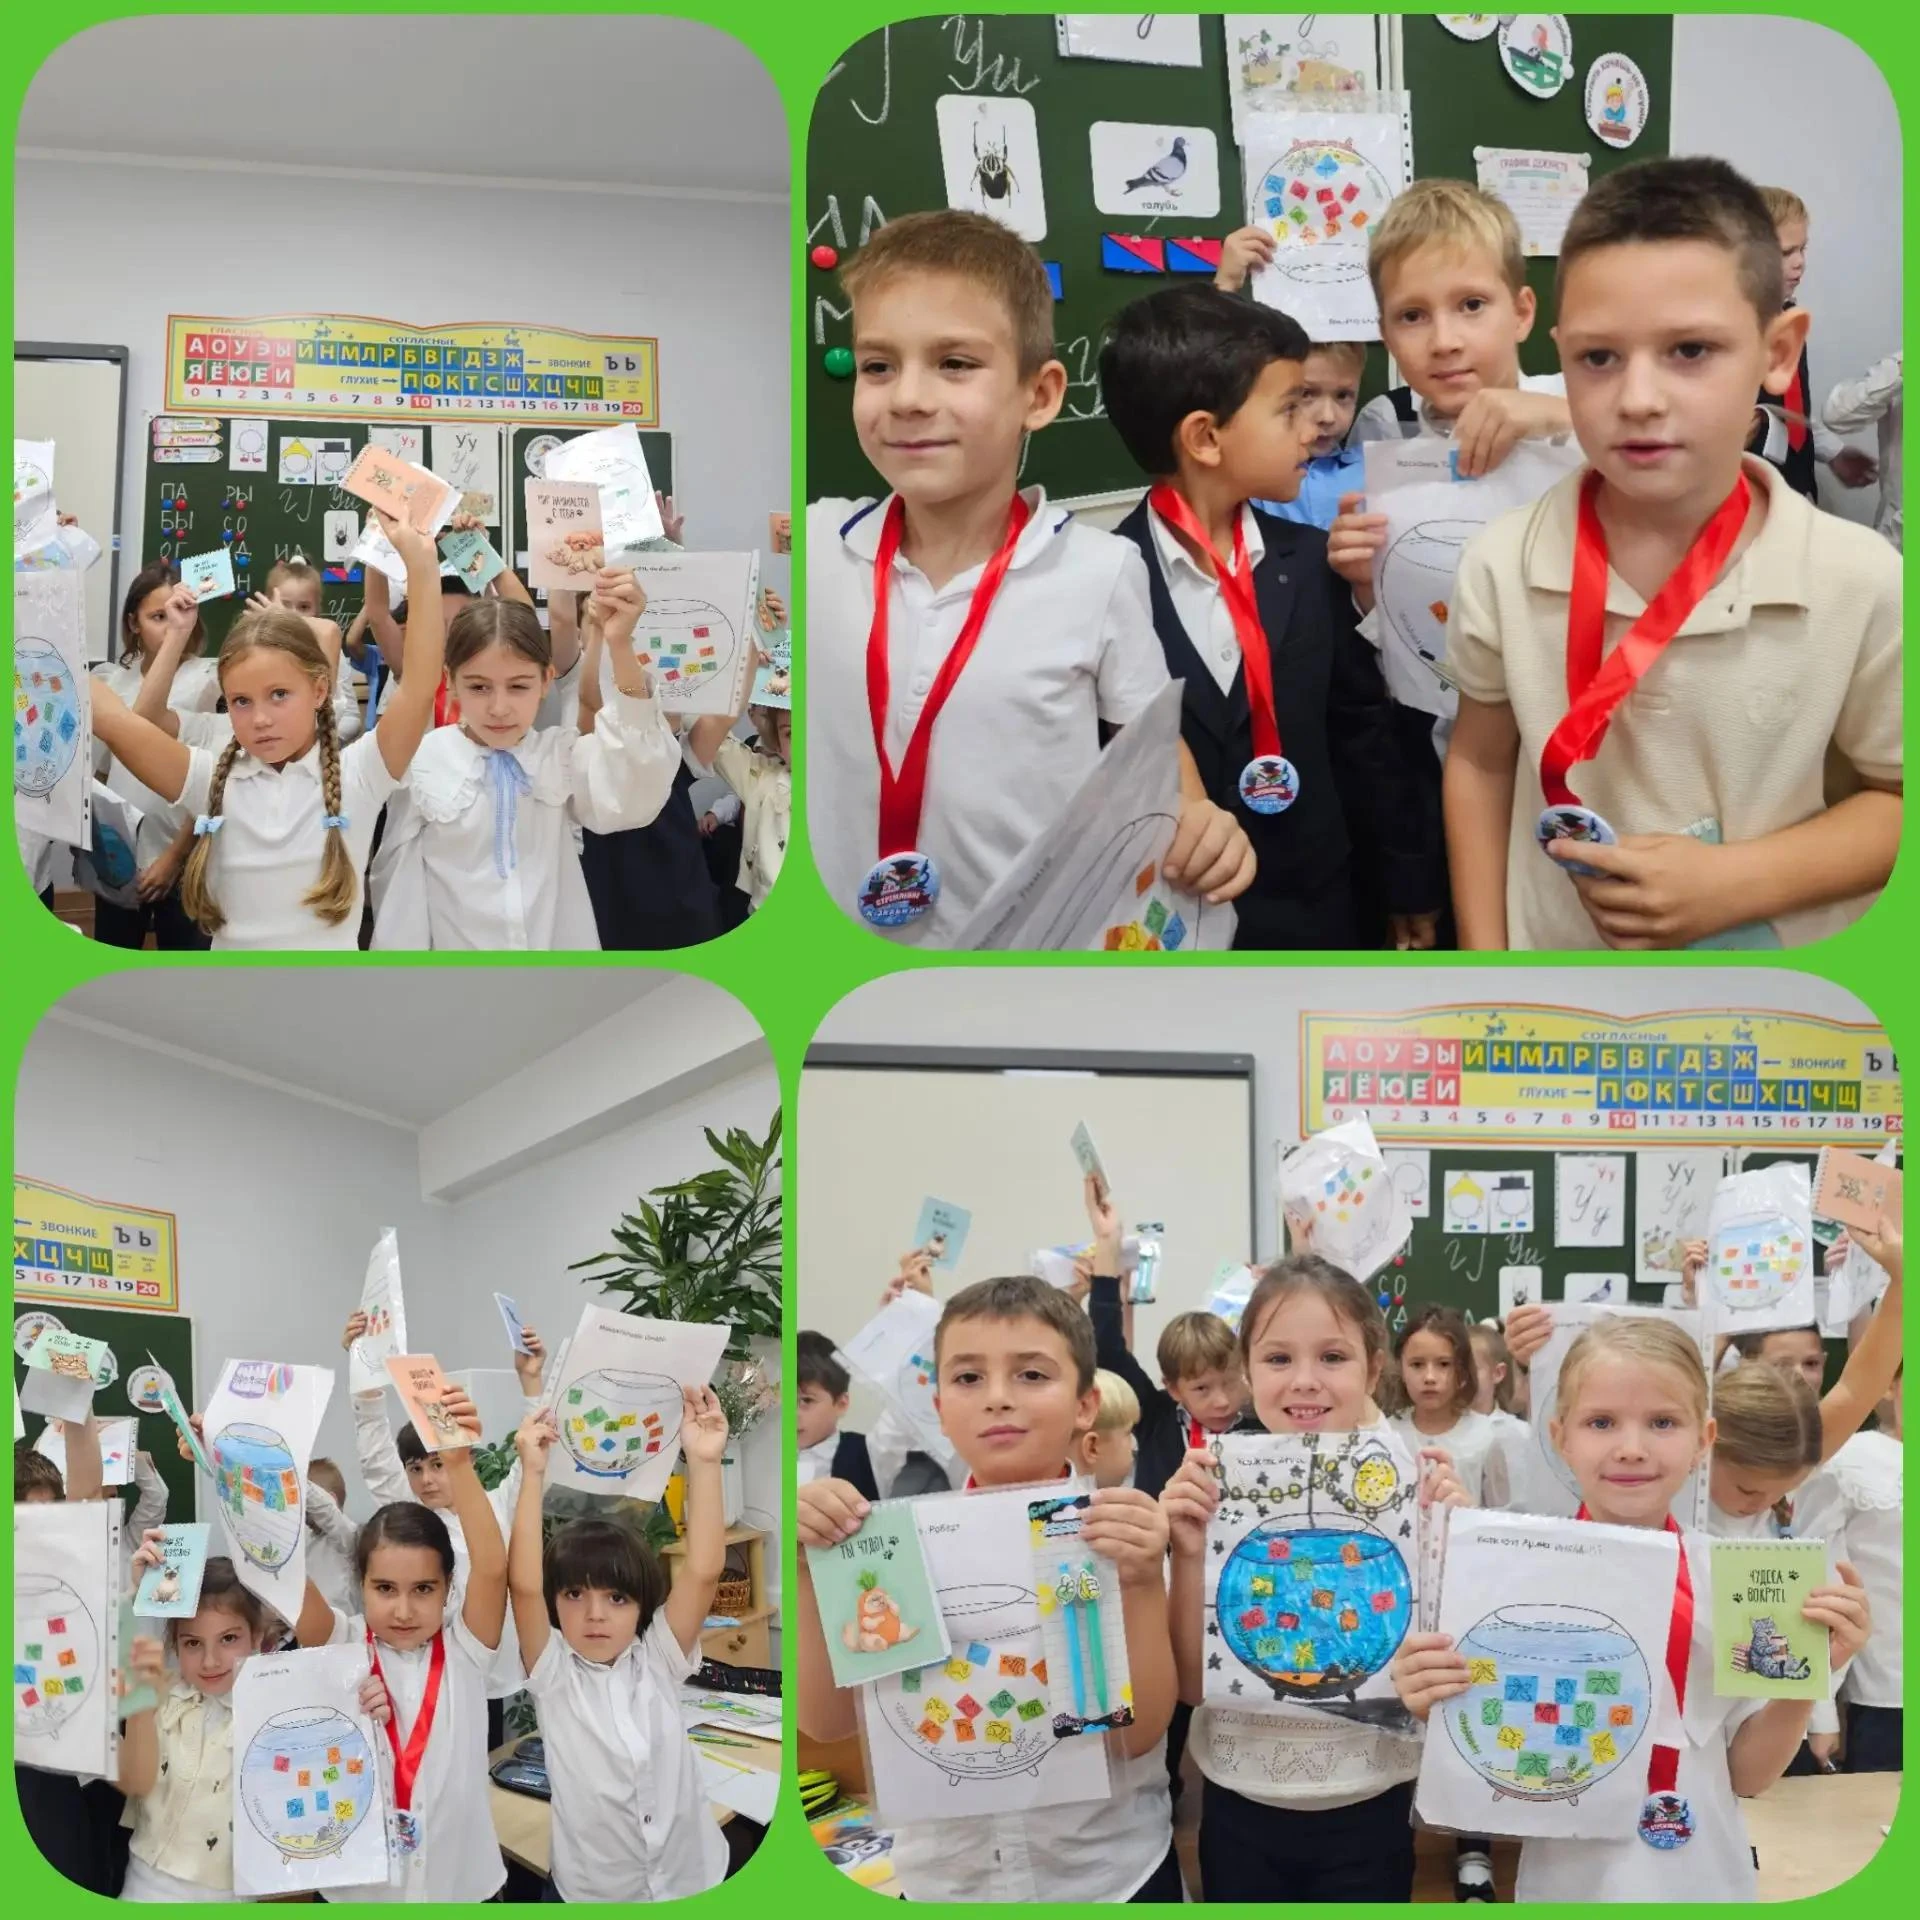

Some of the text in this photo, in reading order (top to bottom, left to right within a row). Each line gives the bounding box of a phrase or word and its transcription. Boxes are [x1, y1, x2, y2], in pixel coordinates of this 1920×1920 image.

[548, 359, 592, 368] ЗВОНКИЕ
[340, 376, 379, 385] ГЛУХИЕ
[191, 389, 641, 413] 0 1 2 3 4 5 6 7 8 9 10 11 12 13 14 15 16 17 18 19 20
[161, 482, 253, 502] ПА РЫ
[161, 510, 247, 534] БЫ СО
[1581, 1032, 1668, 1041] СОГЛАСНЫЕ
[1790, 1058, 1847, 1070] ЗВОНКИЕ
[1518, 1088, 1568, 1098] ГЛУХИЕ
[1333, 1110, 1882, 1129] 0 2 3 4 5 6 7 8 9 10 11 12 13 14 15 16 17 18 19
[40, 1220, 98, 1239] ЗВОНКИЕ
[33, 1271, 55, 1284] 16
[62, 1274, 82, 1286] 17
[88, 1277, 108, 1289] 18
[115, 1280, 134, 1292] 19
[138, 1283, 158, 1294] 20
[1749, 1569, 1784, 1586] ЧУДЕСА
